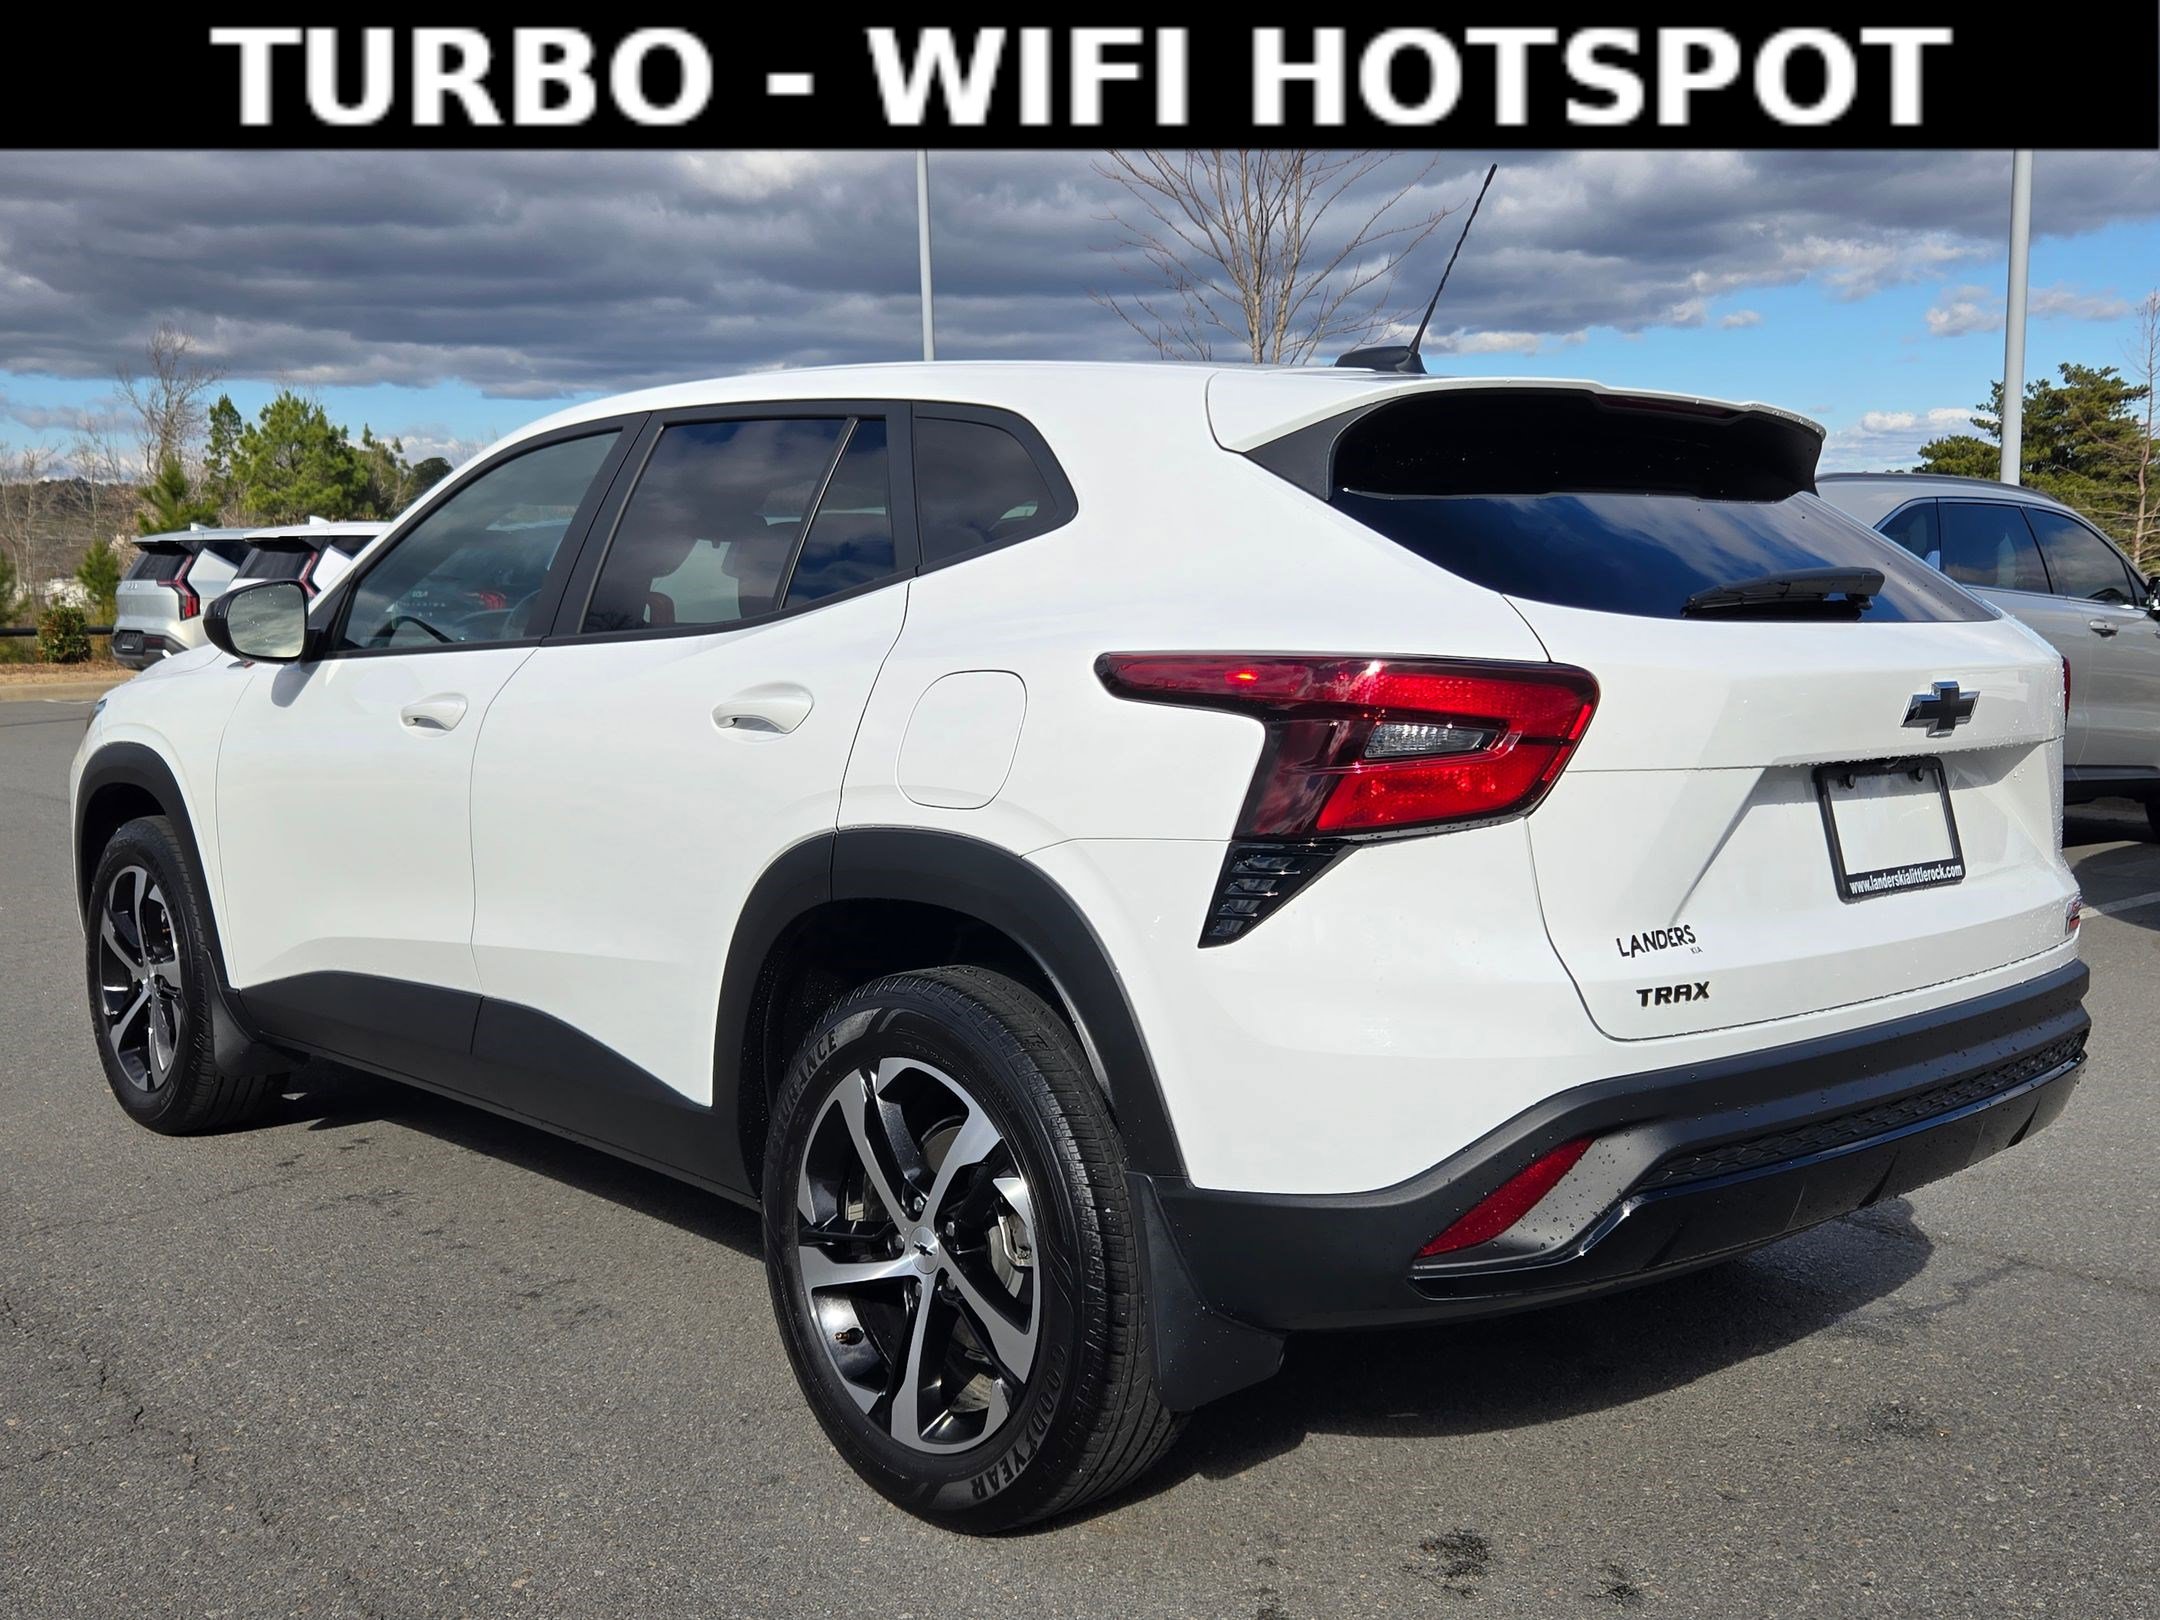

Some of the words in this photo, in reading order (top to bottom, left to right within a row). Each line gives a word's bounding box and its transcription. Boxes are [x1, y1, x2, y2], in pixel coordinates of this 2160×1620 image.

[1849, 864, 1963, 894] www.landerskialittlerock.com
[1616, 924, 1697, 958] LANDERS
[1636, 981, 1710, 1007] TRAX
